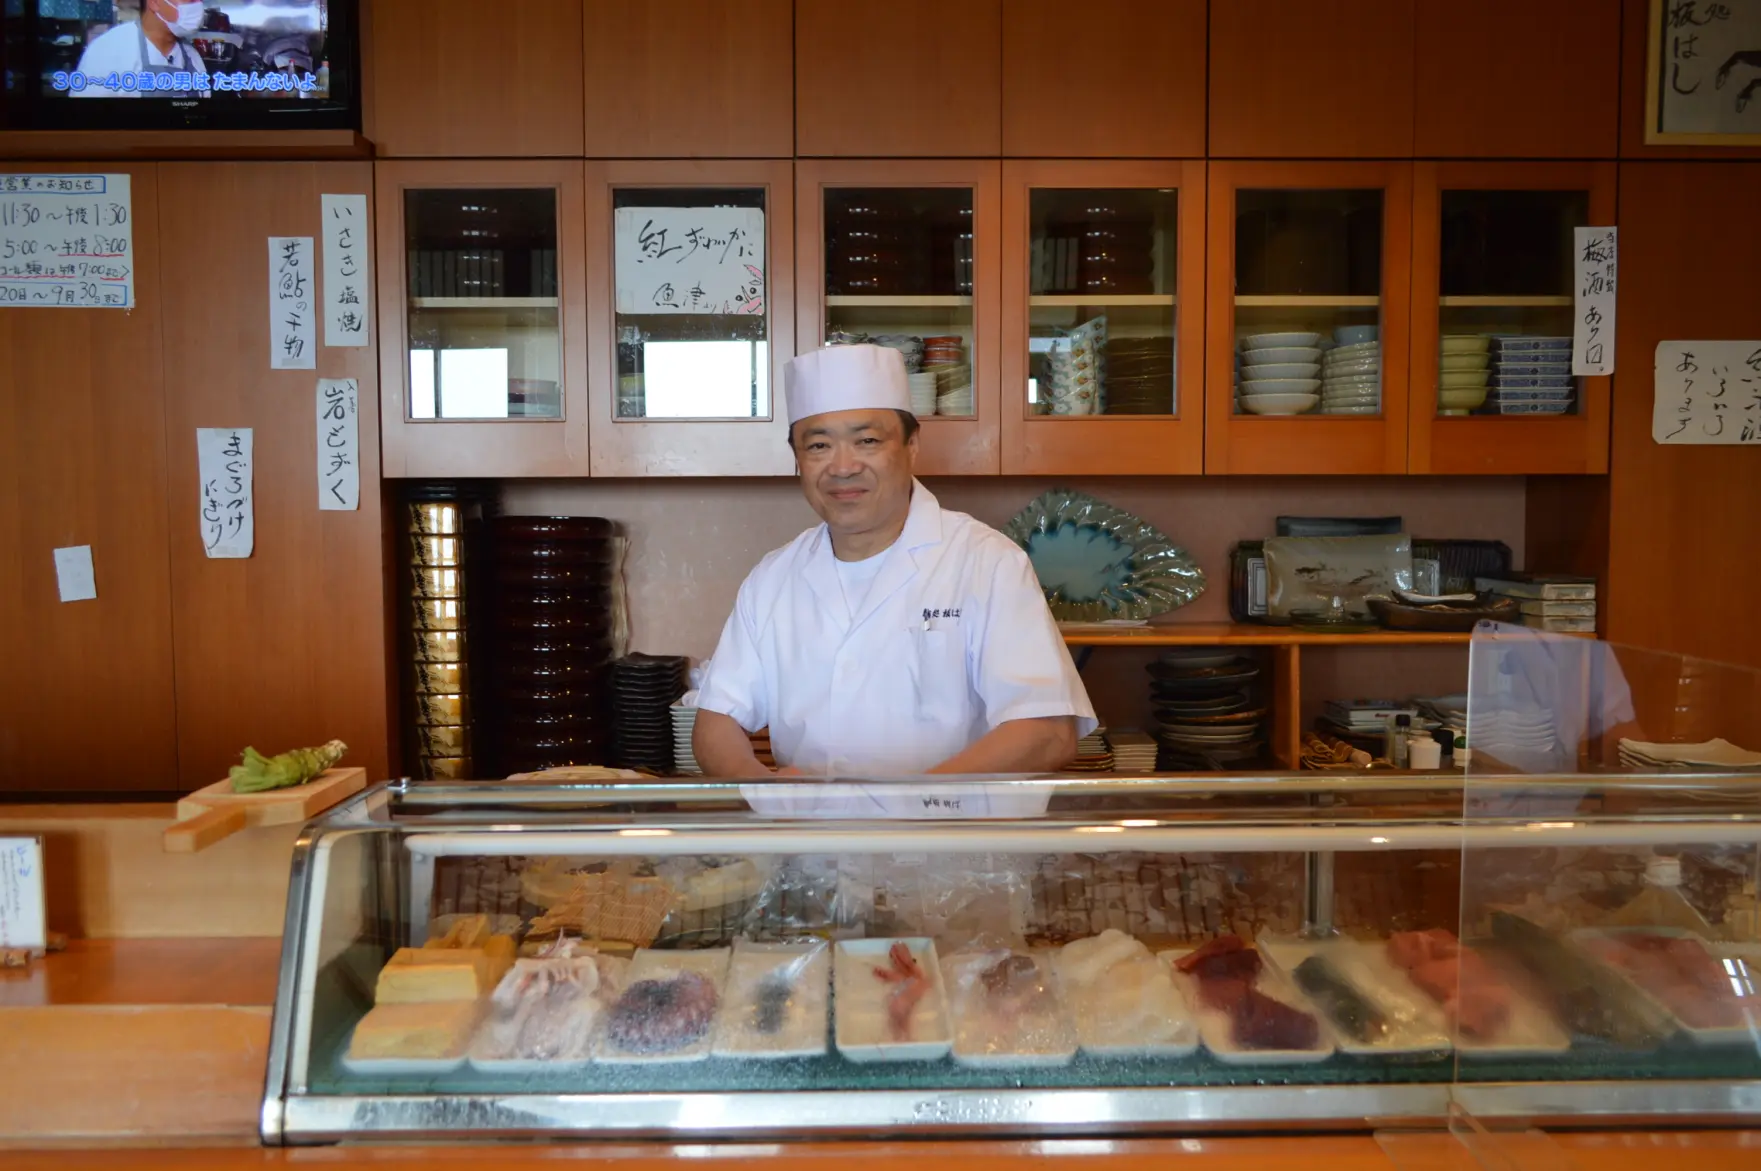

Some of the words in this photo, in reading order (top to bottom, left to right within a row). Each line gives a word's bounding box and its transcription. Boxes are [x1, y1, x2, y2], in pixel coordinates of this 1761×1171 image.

[213, 72, 318, 92] たまんないよ
[0, 175, 95, 191] 営業のお知らせ
[333, 207, 363, 333] いさき塩焼
[323, 386, 351, 505] 岩もずく
[203, 479, 223, 550] にぎり
